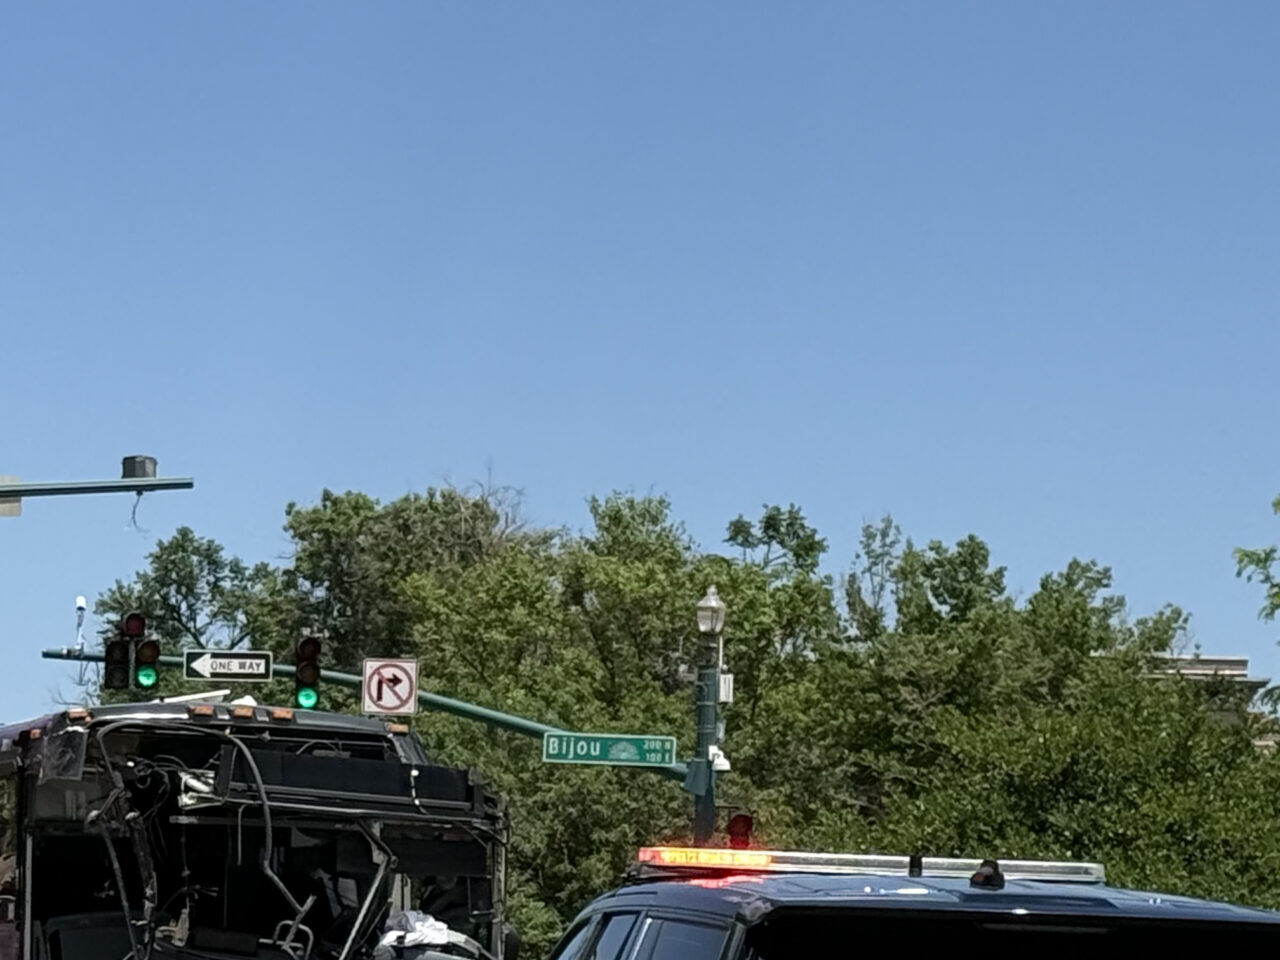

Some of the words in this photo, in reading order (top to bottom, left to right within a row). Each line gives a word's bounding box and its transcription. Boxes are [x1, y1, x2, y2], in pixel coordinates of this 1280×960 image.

[210, 661, 234, 671] ONE
[238, 662, 262, 671] WAY
[548, 737, 600, 759] Bijou
